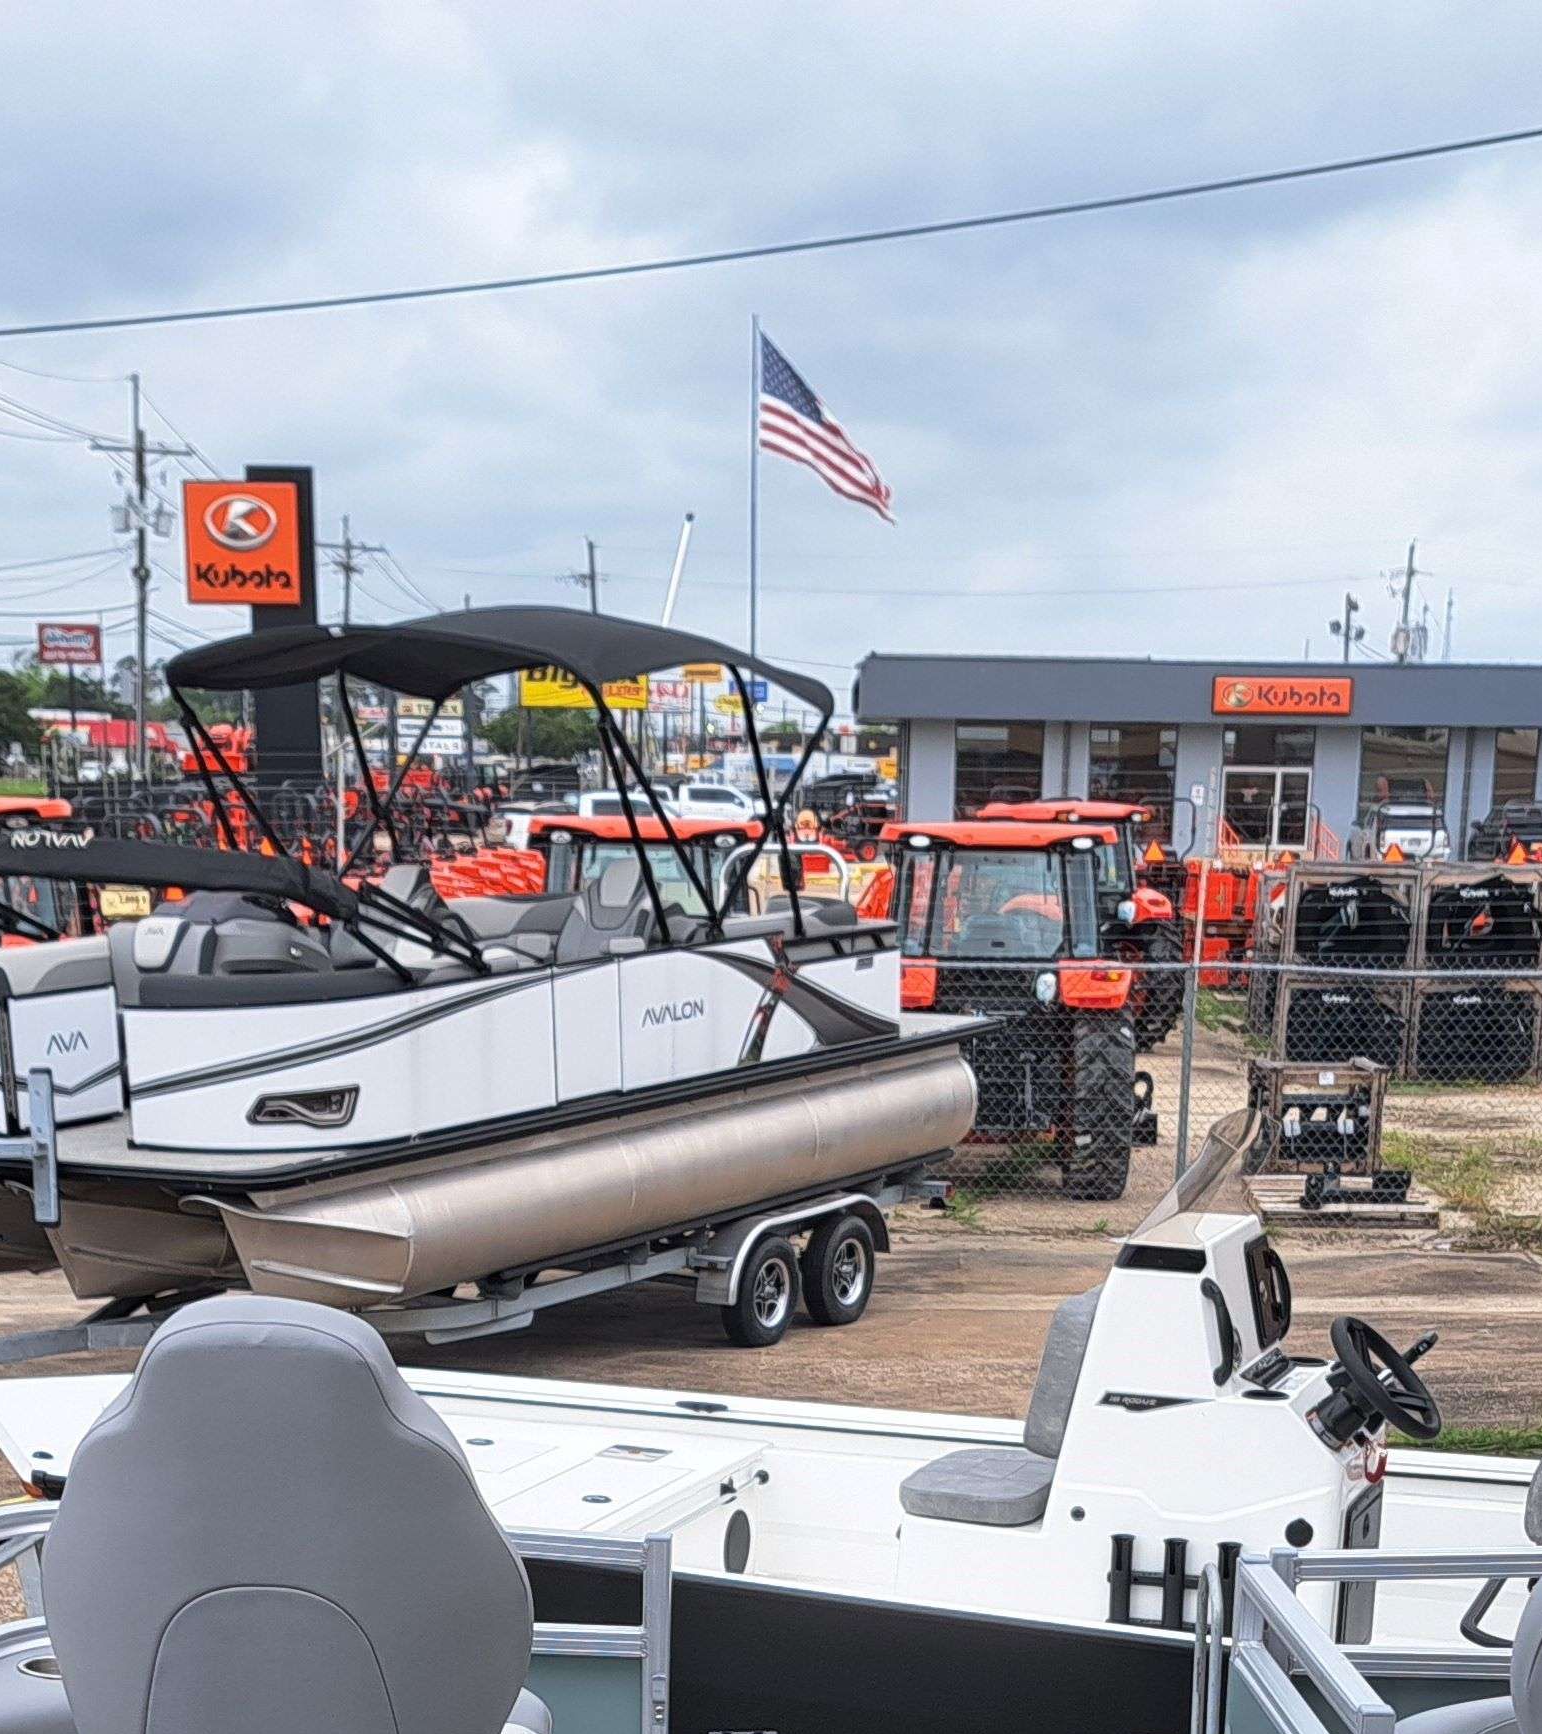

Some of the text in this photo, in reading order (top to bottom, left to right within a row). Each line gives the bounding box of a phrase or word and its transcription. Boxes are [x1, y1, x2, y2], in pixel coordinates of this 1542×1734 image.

[195, 562, 293, 590] Kubota
[1258, 685, 1341, 707] Kubota
[642, 999, 705, 1028] AVALON
[46, 1030, 89, 1056] AVA
